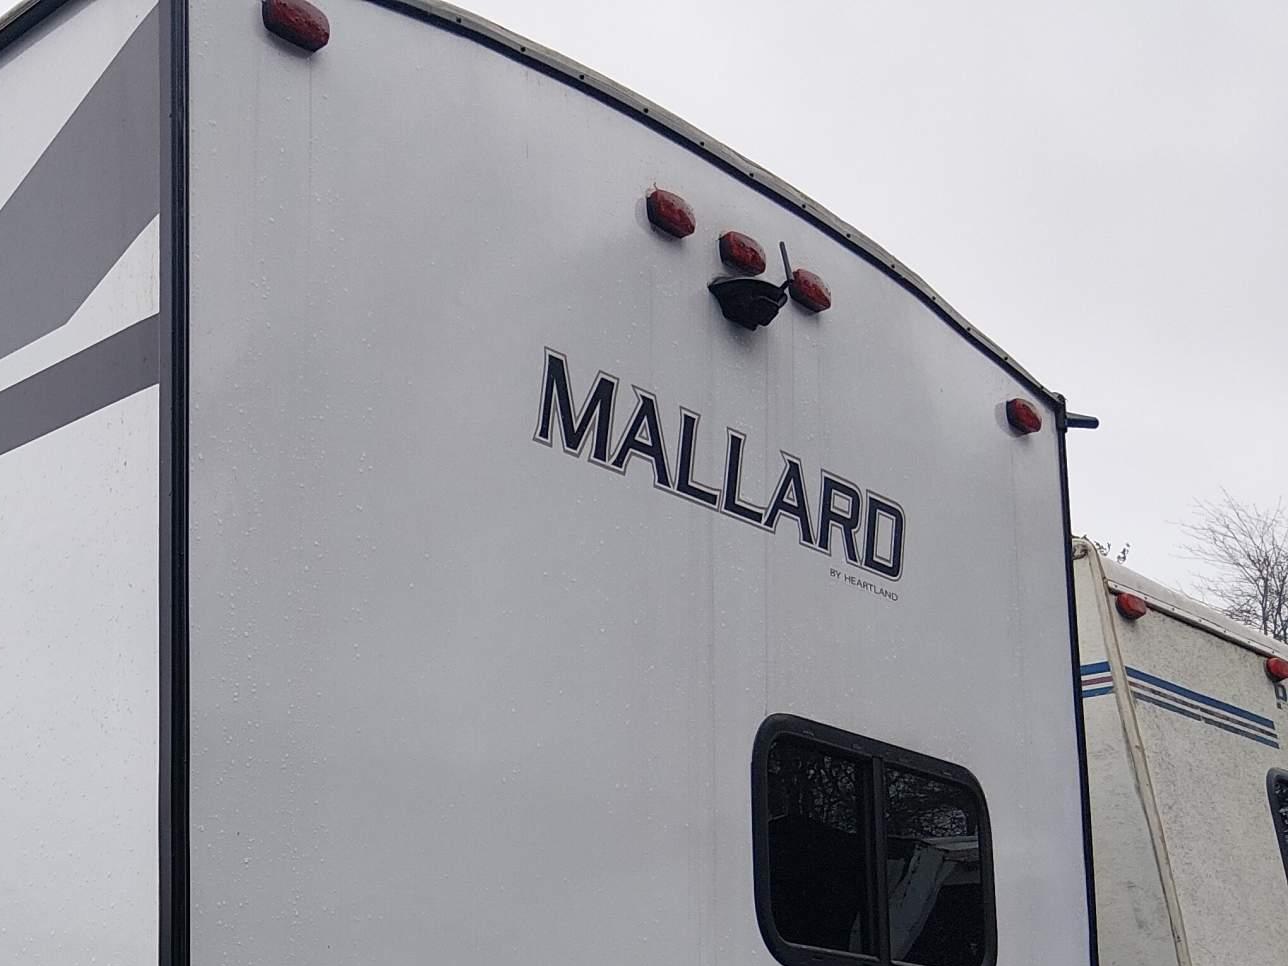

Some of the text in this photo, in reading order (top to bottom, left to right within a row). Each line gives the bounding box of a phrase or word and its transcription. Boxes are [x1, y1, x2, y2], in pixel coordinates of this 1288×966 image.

[533, 346, 906, 582] MALLARD
[829, 568, 898, 601] BY HEARTLAND
